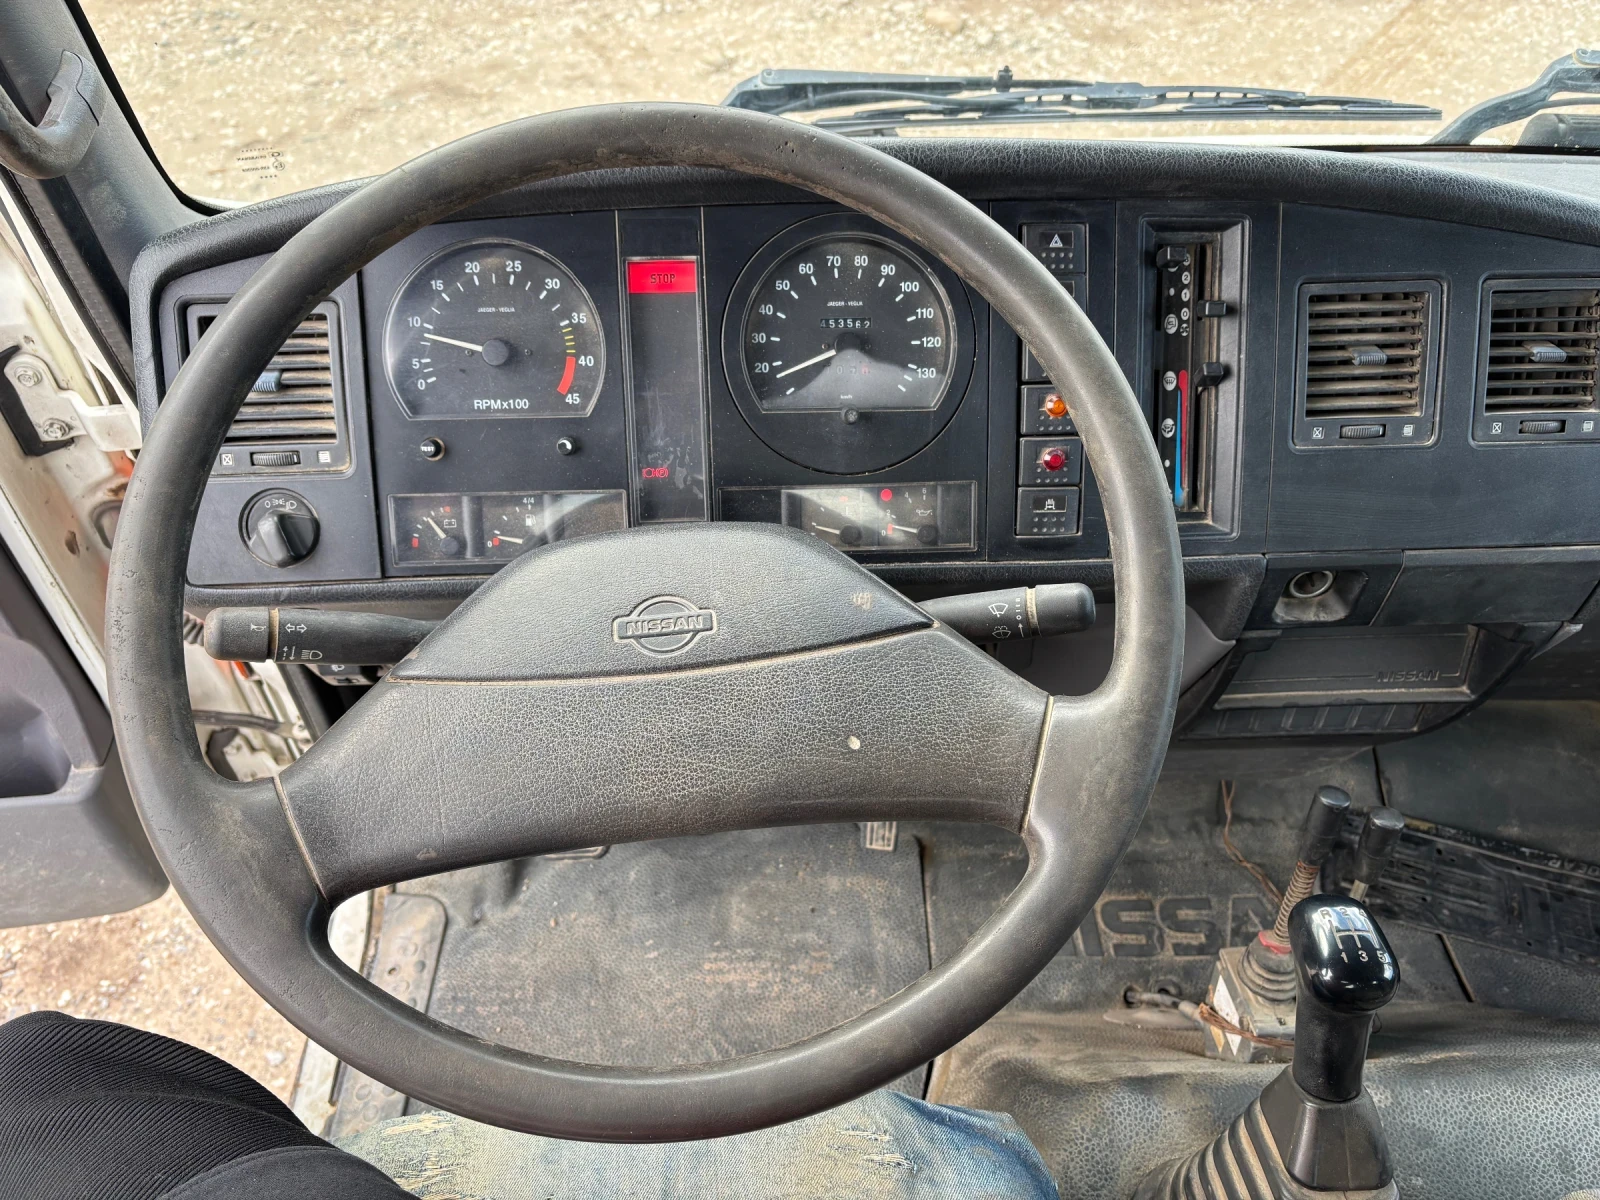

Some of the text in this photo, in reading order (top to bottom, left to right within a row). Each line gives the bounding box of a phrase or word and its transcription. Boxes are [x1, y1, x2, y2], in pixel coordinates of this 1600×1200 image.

[506, 261, 522, 271] 25
[826, 256, 841, 267] 70
[854, 256, 868, 266] 80
[465, 262, 480, 272] 20
[799, 263, 813, 274] 60
[881, 265, 895, 275] 90
[650, 273, 676, 284] STOP
[430, 280, 444, 290] 15
[545, 279, 560, 289] 30
[775, 281, 790, 291] 50
[900, 282, 919, 292] 100
[759, 305, 773, 315] 40
[916, 308, 934, 318] 110
[407, 317, 421, 327] 10
[571, 313, 587, 323] 35
[752, 333, 766, 343] 30
[921, 337, 941, 347] 120
[412, 359, 420, 369] 5
[579, 356, 594, 366] 40
[755, 363, 769, 373] 20
[916, 368, 936, 378] 130
[417, 380, 426, 390] 0
[565, 393, 580, 404] 45
[474, 399, 529, 409] RPMx100
[625, 615, 704, 635] NISSAN
[1377, 670, 1440, 682] NISSAN
[1320, 909, 1332, 920] R
[1339, 908, 1350, 916] 2
[1340, 950, 1388, 963] 1 3 5
